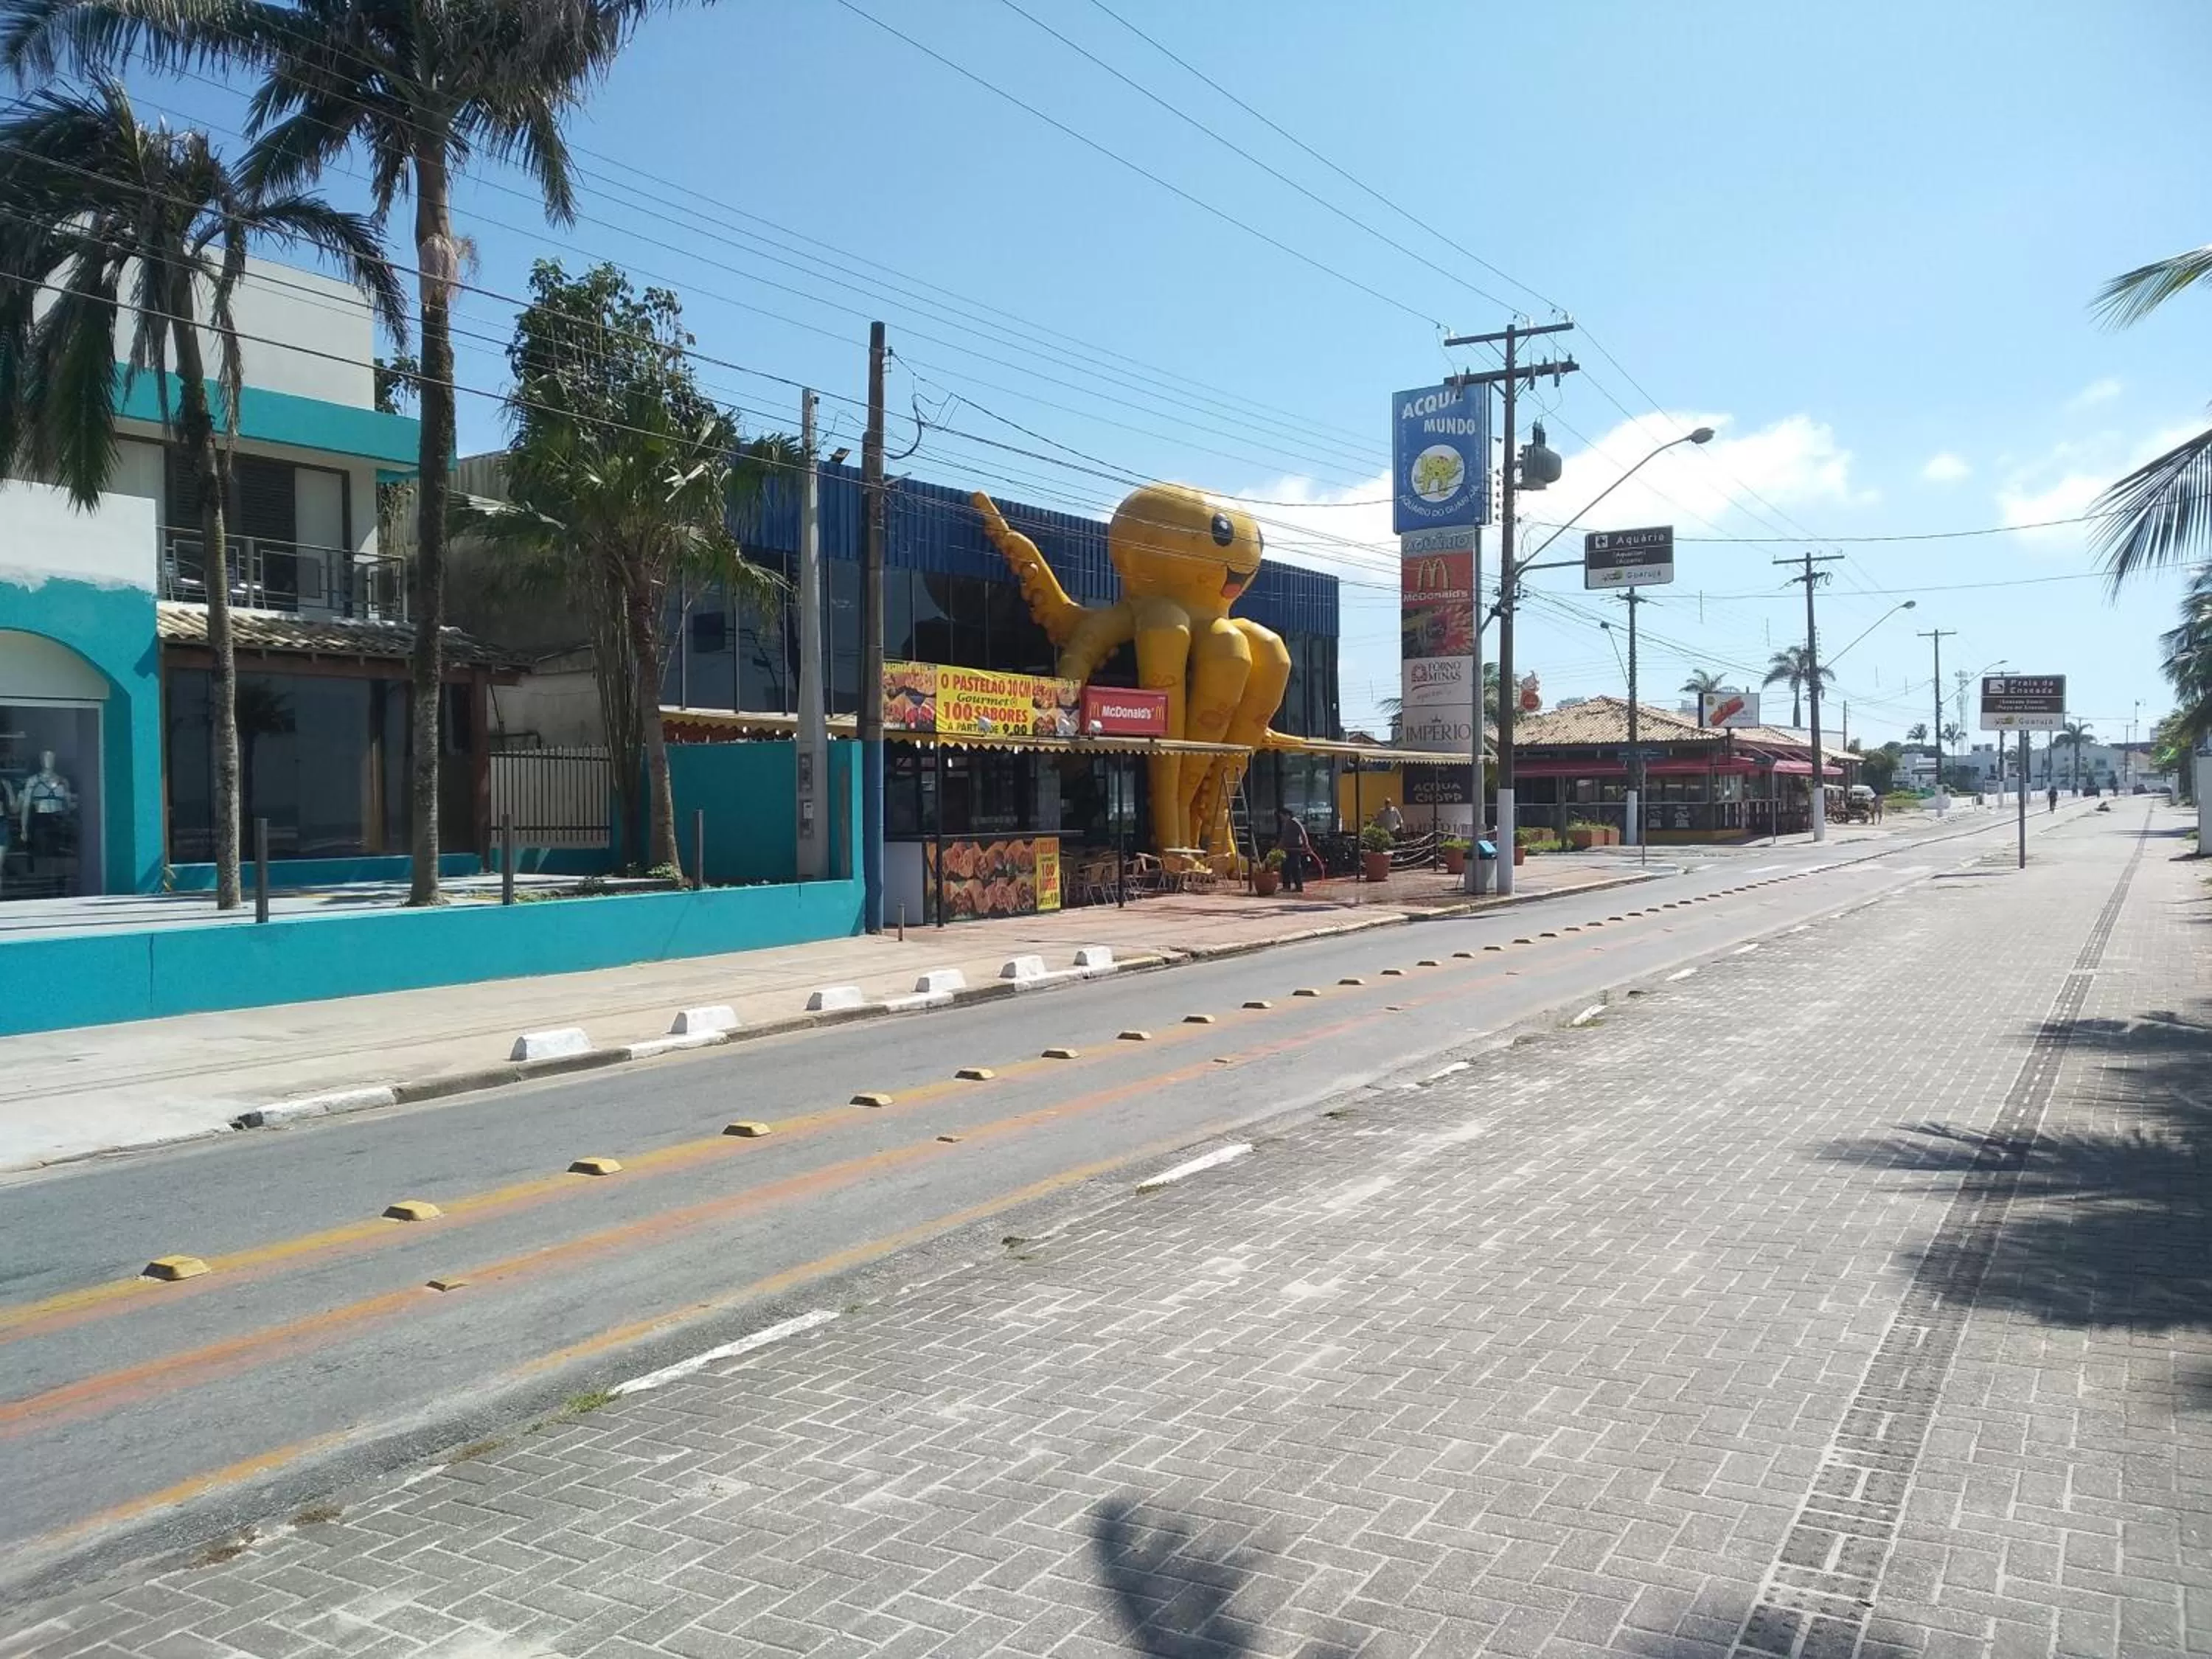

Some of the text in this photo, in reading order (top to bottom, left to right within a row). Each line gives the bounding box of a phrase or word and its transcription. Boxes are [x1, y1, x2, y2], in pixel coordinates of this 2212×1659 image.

[1424, 418, 1475, 434] MUNDO
[1615, 533, 1664, 546] Aquário
[1403, 589, 1468, 602] McDonald's
[941, 673, 949, 689] O
[2010, 678, 2038, 686] Praia
[957, 692, 1010, 706] Gourmet
[944, 701, 1029, 723] 100 SABORES
[1102, 706, 1151, 720] McDonald's
